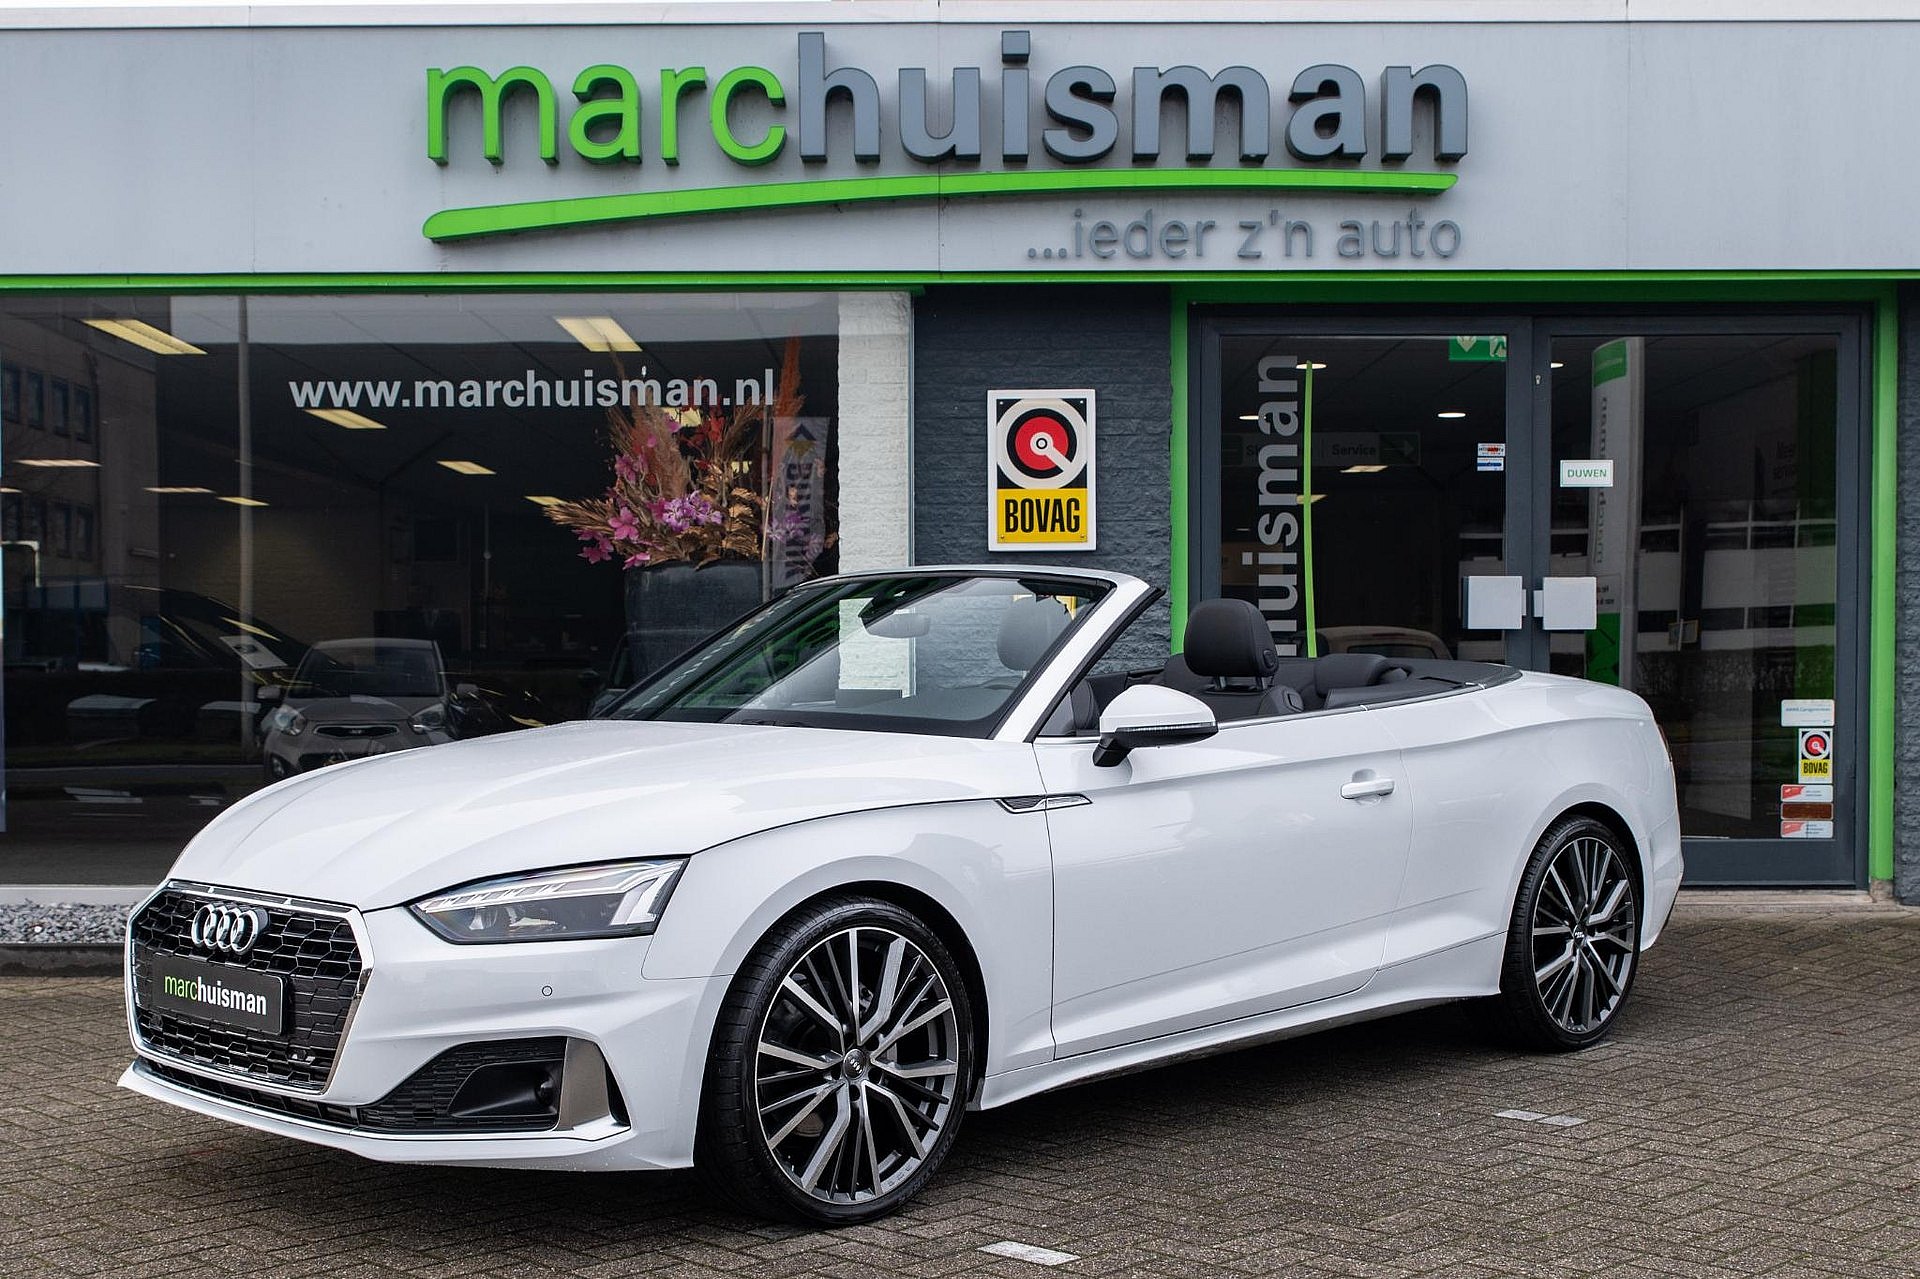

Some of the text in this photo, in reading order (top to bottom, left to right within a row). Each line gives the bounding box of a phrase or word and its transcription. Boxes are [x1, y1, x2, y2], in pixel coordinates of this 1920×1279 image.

[426, 30, 1468, 166] marchuisman
[1237, 208, 1315, 258] z'n
[1336, 208, 1462, 258] auto
[288, 368, 776, 409] www.marchuisman.nl
[1331, 443, 1377, 457] Service
[1566, 467, 1607, 479] DUWEN
[1004, 498, 1080, 533] BOVAG
[1803, 761, 1828, 774] BOVAG
[164, 976, 267, 1015] marchuisman
